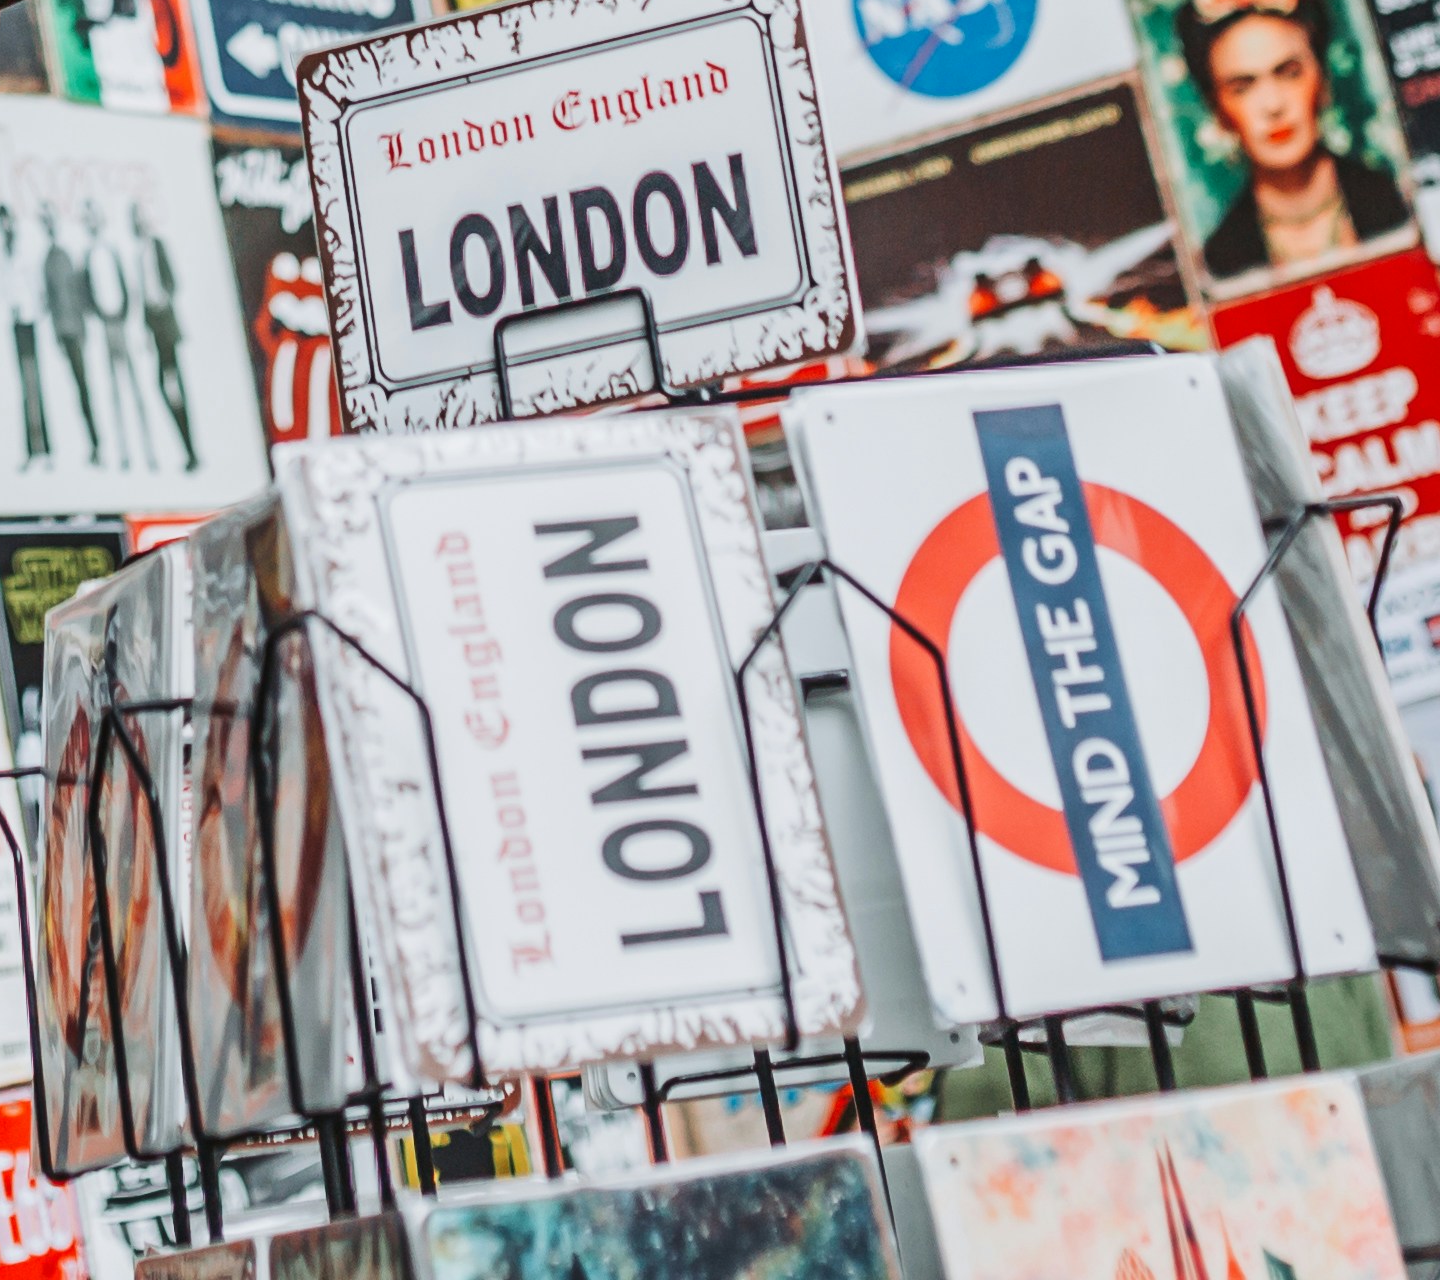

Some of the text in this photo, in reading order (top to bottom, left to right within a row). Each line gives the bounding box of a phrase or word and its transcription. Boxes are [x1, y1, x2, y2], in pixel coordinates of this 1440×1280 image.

[379, 60, 731, 173] London England
[398, 153, 760, 332] LONDON
[434, 530, 556, 974] London England
[531, 515, 731, 948] LONDON
[1003, 454, 1162, 910] MIND THE GAP
